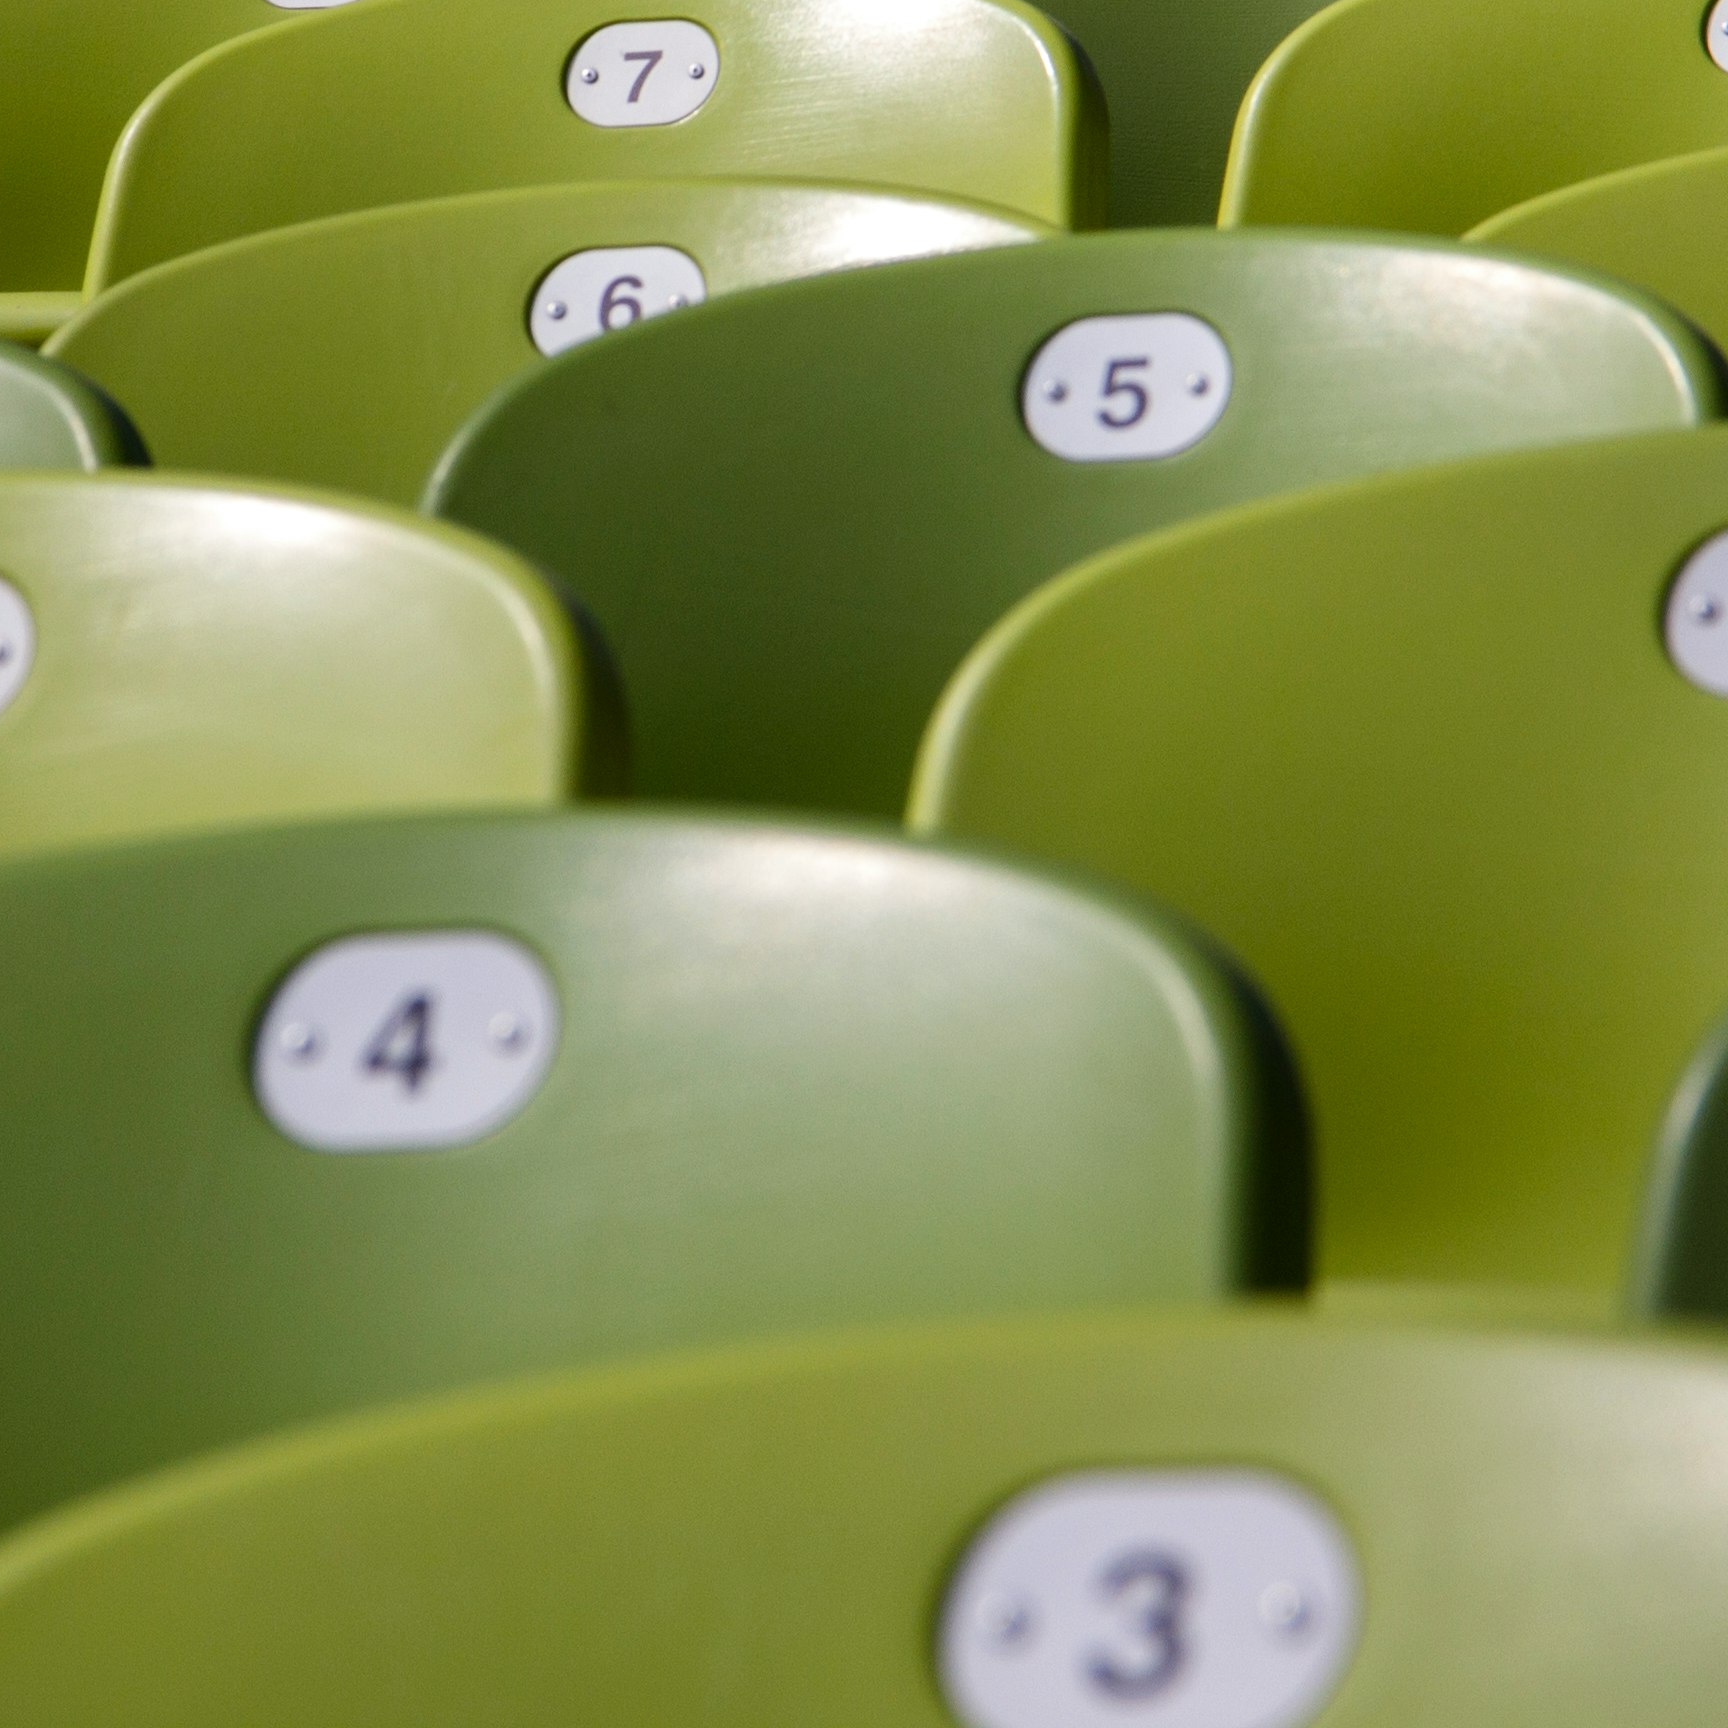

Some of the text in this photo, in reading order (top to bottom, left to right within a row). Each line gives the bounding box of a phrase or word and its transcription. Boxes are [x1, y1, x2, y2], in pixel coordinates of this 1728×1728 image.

[623, 49, 664, 104] 7
[598, 275, 643, 333] 6
[1097, 356, 1150, 431] 5
[362, 991, 435, 1093] 4
[1086, 1550, 1196, 1702] 3
